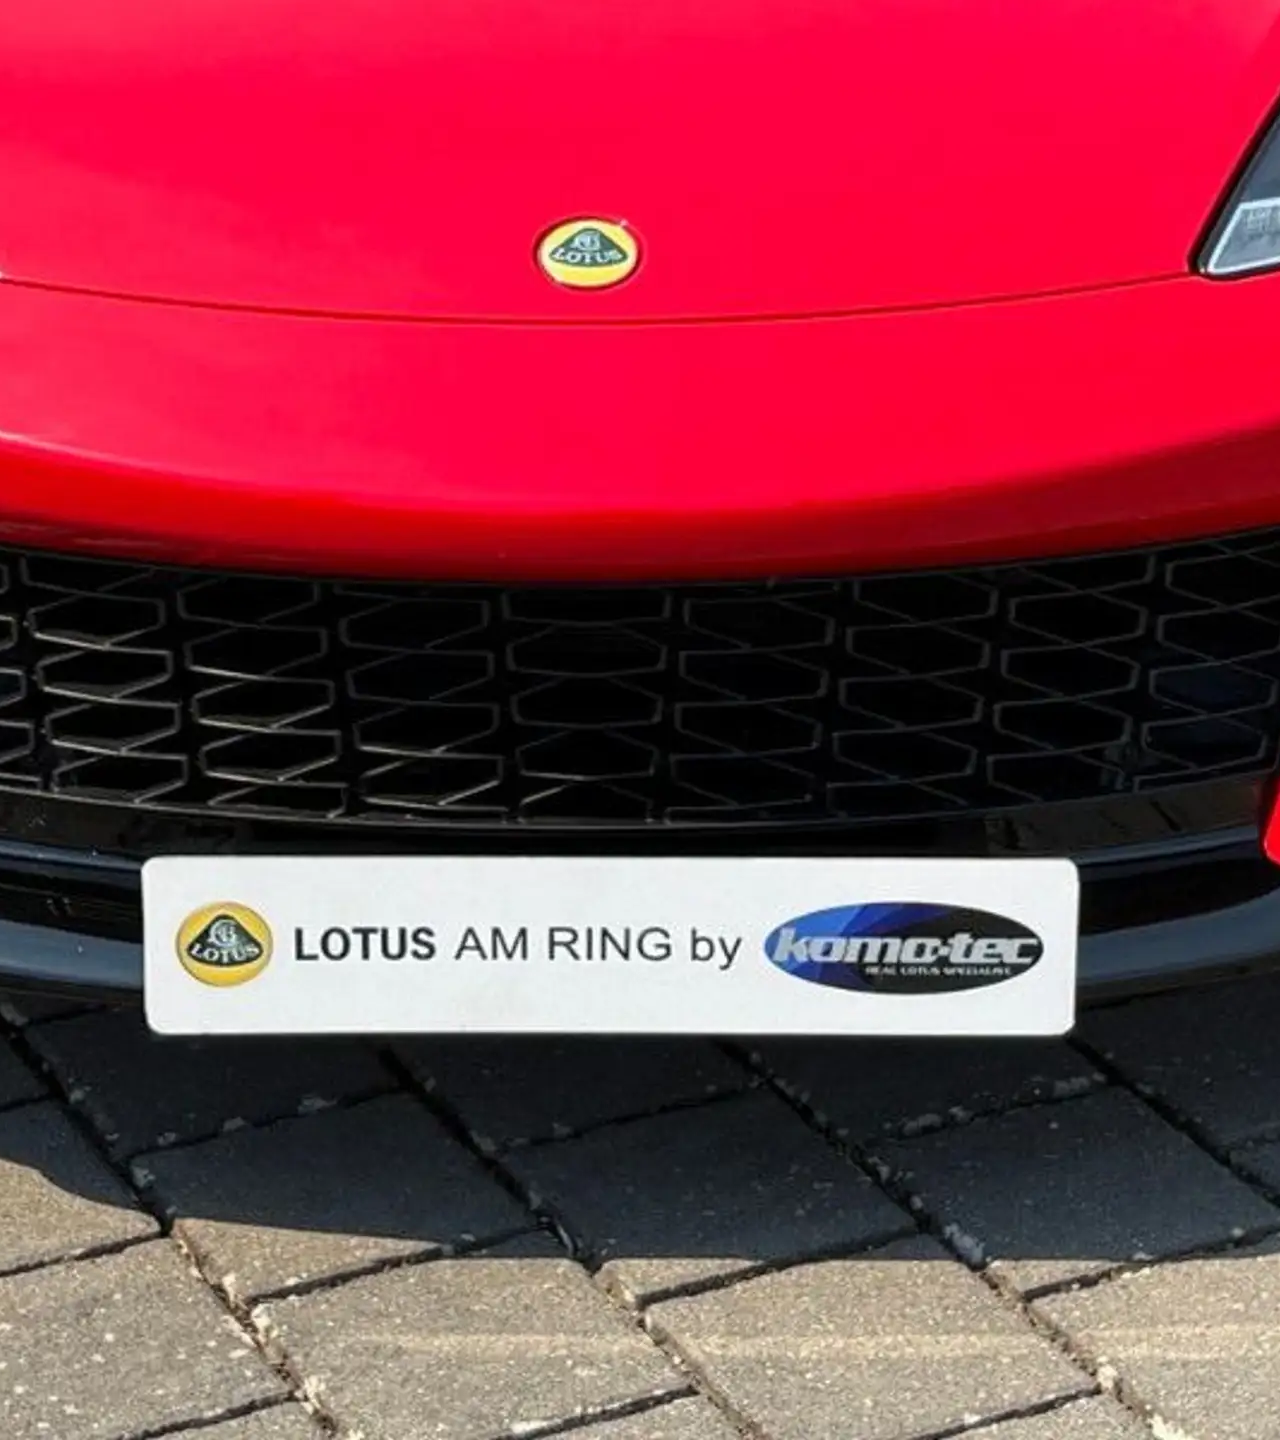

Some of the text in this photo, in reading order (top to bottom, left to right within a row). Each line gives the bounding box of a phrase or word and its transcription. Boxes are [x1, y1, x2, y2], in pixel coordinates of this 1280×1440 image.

[551, 247, 623, 264] LOTUS
[190, 943, 260, 964] LOTUS
[294, 926, 437, 961] LOTUS
[455, 926, 528, 961] AM
[548, 926, 672, 961] RING
[690, 927, 742, 970] by
